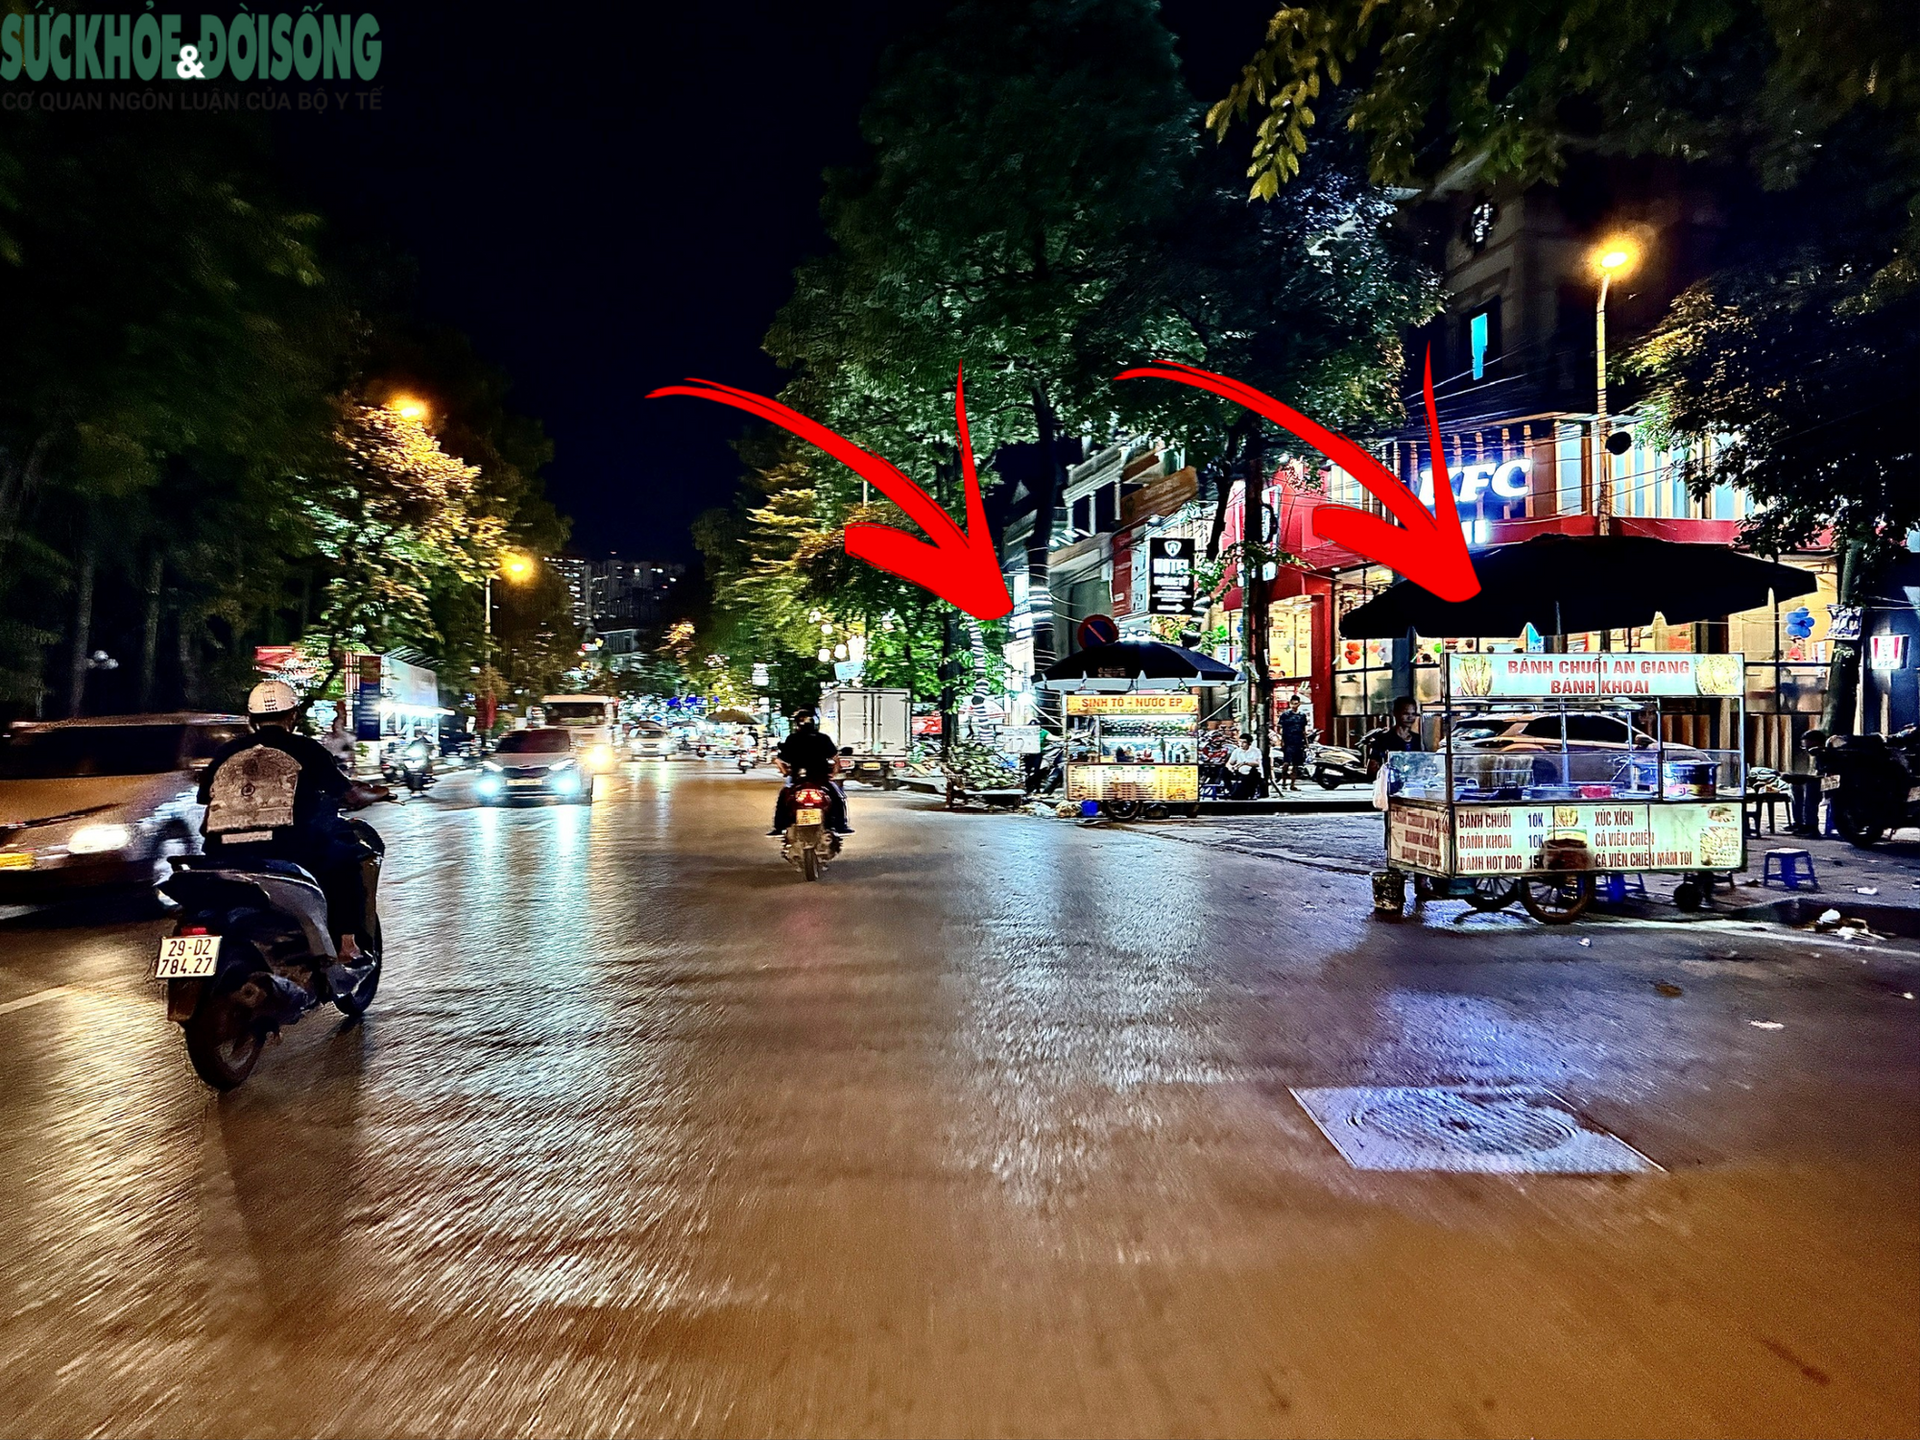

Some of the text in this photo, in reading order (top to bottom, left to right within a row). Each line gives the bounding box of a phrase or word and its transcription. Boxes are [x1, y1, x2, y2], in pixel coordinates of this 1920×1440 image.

[1419, 458, 1532, 506] KFC
[1507, 657, 1553, 674] BÁNH
[1613, 660, 1635, 674] AN
[1641, 660, 1690, 674] GIANG
[1550, 677, 1649, 694] BÁNH KHOAI
[1082, 698, 1108, 708] SINH
[1459, 810, 1482, 828] BÁNH
[1528, 812, 1544, 828] 10K
[1595, 808, 1634, 827] XÚC XÍCH
[1459, 832, 1544, 849] BÁNH KHOAI 10K
[1595, 829, 1607, 847] CÁ
[1460, 852, 1484, 871] BÁNH
[1486, 855, 1502, 870] HOT
[1505, 855, 1522, 870] DOG
[1595, 850, 1607, 868] CÁ
[159, 957, 213, 975] 784.27
